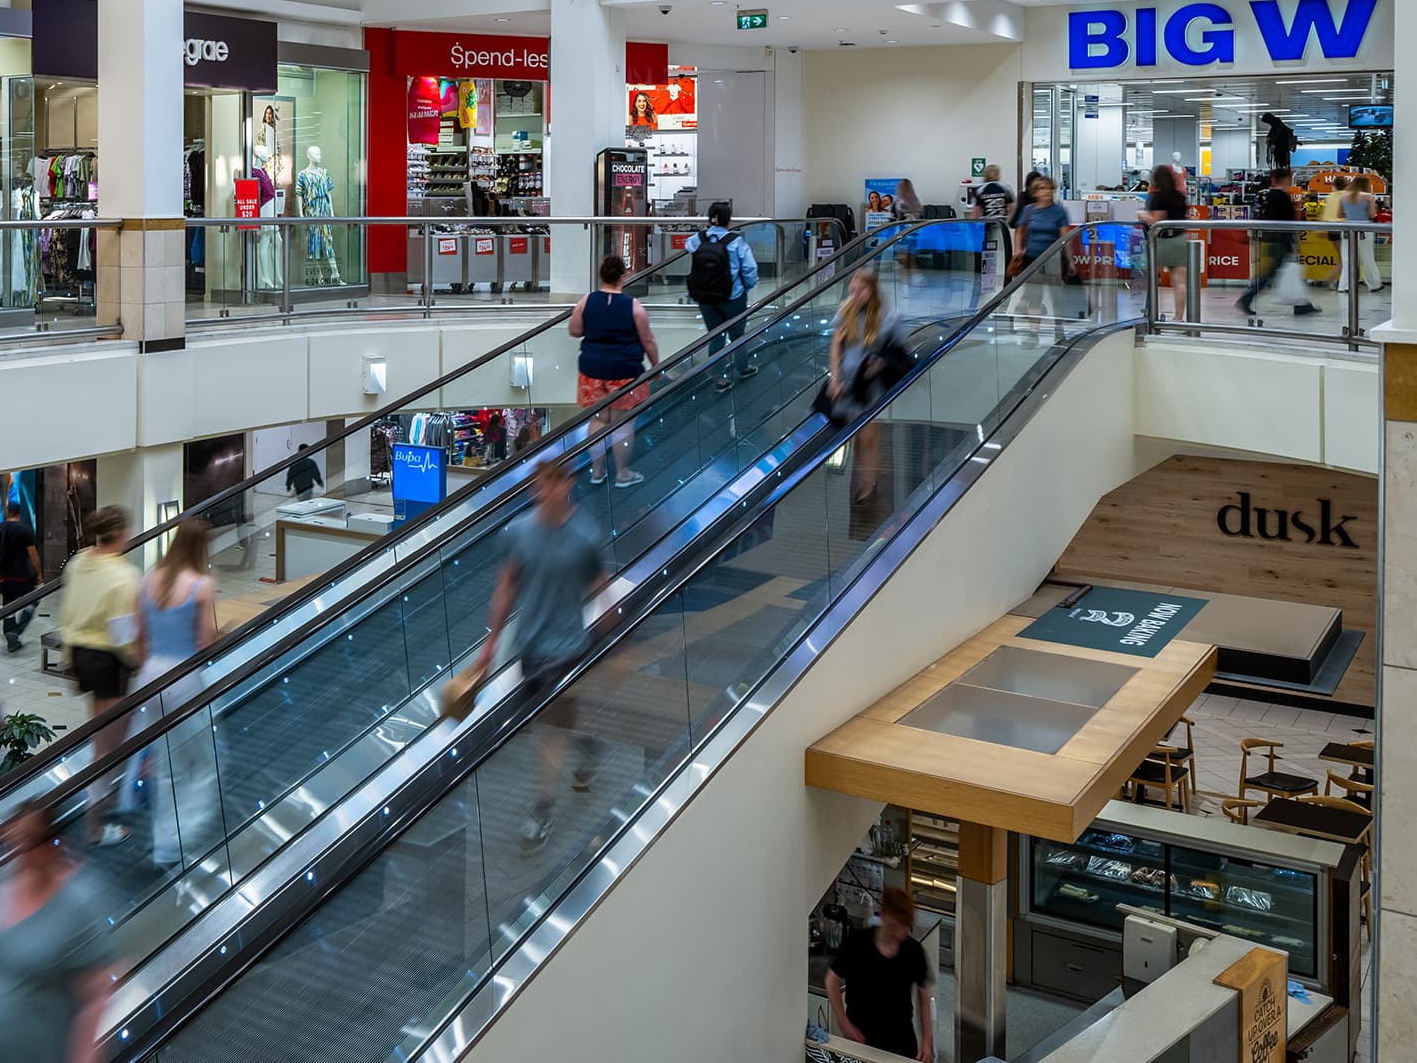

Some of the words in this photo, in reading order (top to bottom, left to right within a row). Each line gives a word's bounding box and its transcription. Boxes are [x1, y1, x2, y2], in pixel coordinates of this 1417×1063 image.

[1069, 2, 1235, 70] BIG
[612, 164, 646, 173] CHOCOLATE
[618, 175, 641, 184] ENERGY
[1208, 256, 1239, 266] RICE
[395, 450, 421, 464] Bupa
[1216, 491, 1360, 549] dusk
[1147, 602, 1182, 621] NOW
[1119, 618, 1166, 646] BAKING
[1254, 995, 1276, 1023] CATCH
[1247, 1025, 1257, 1042] UP
[1258, 1011, 1277, 1034] OVER
[1276, 1005, 1282, 1018] A
[1251, 1030, 1279, 1063] Coffee
